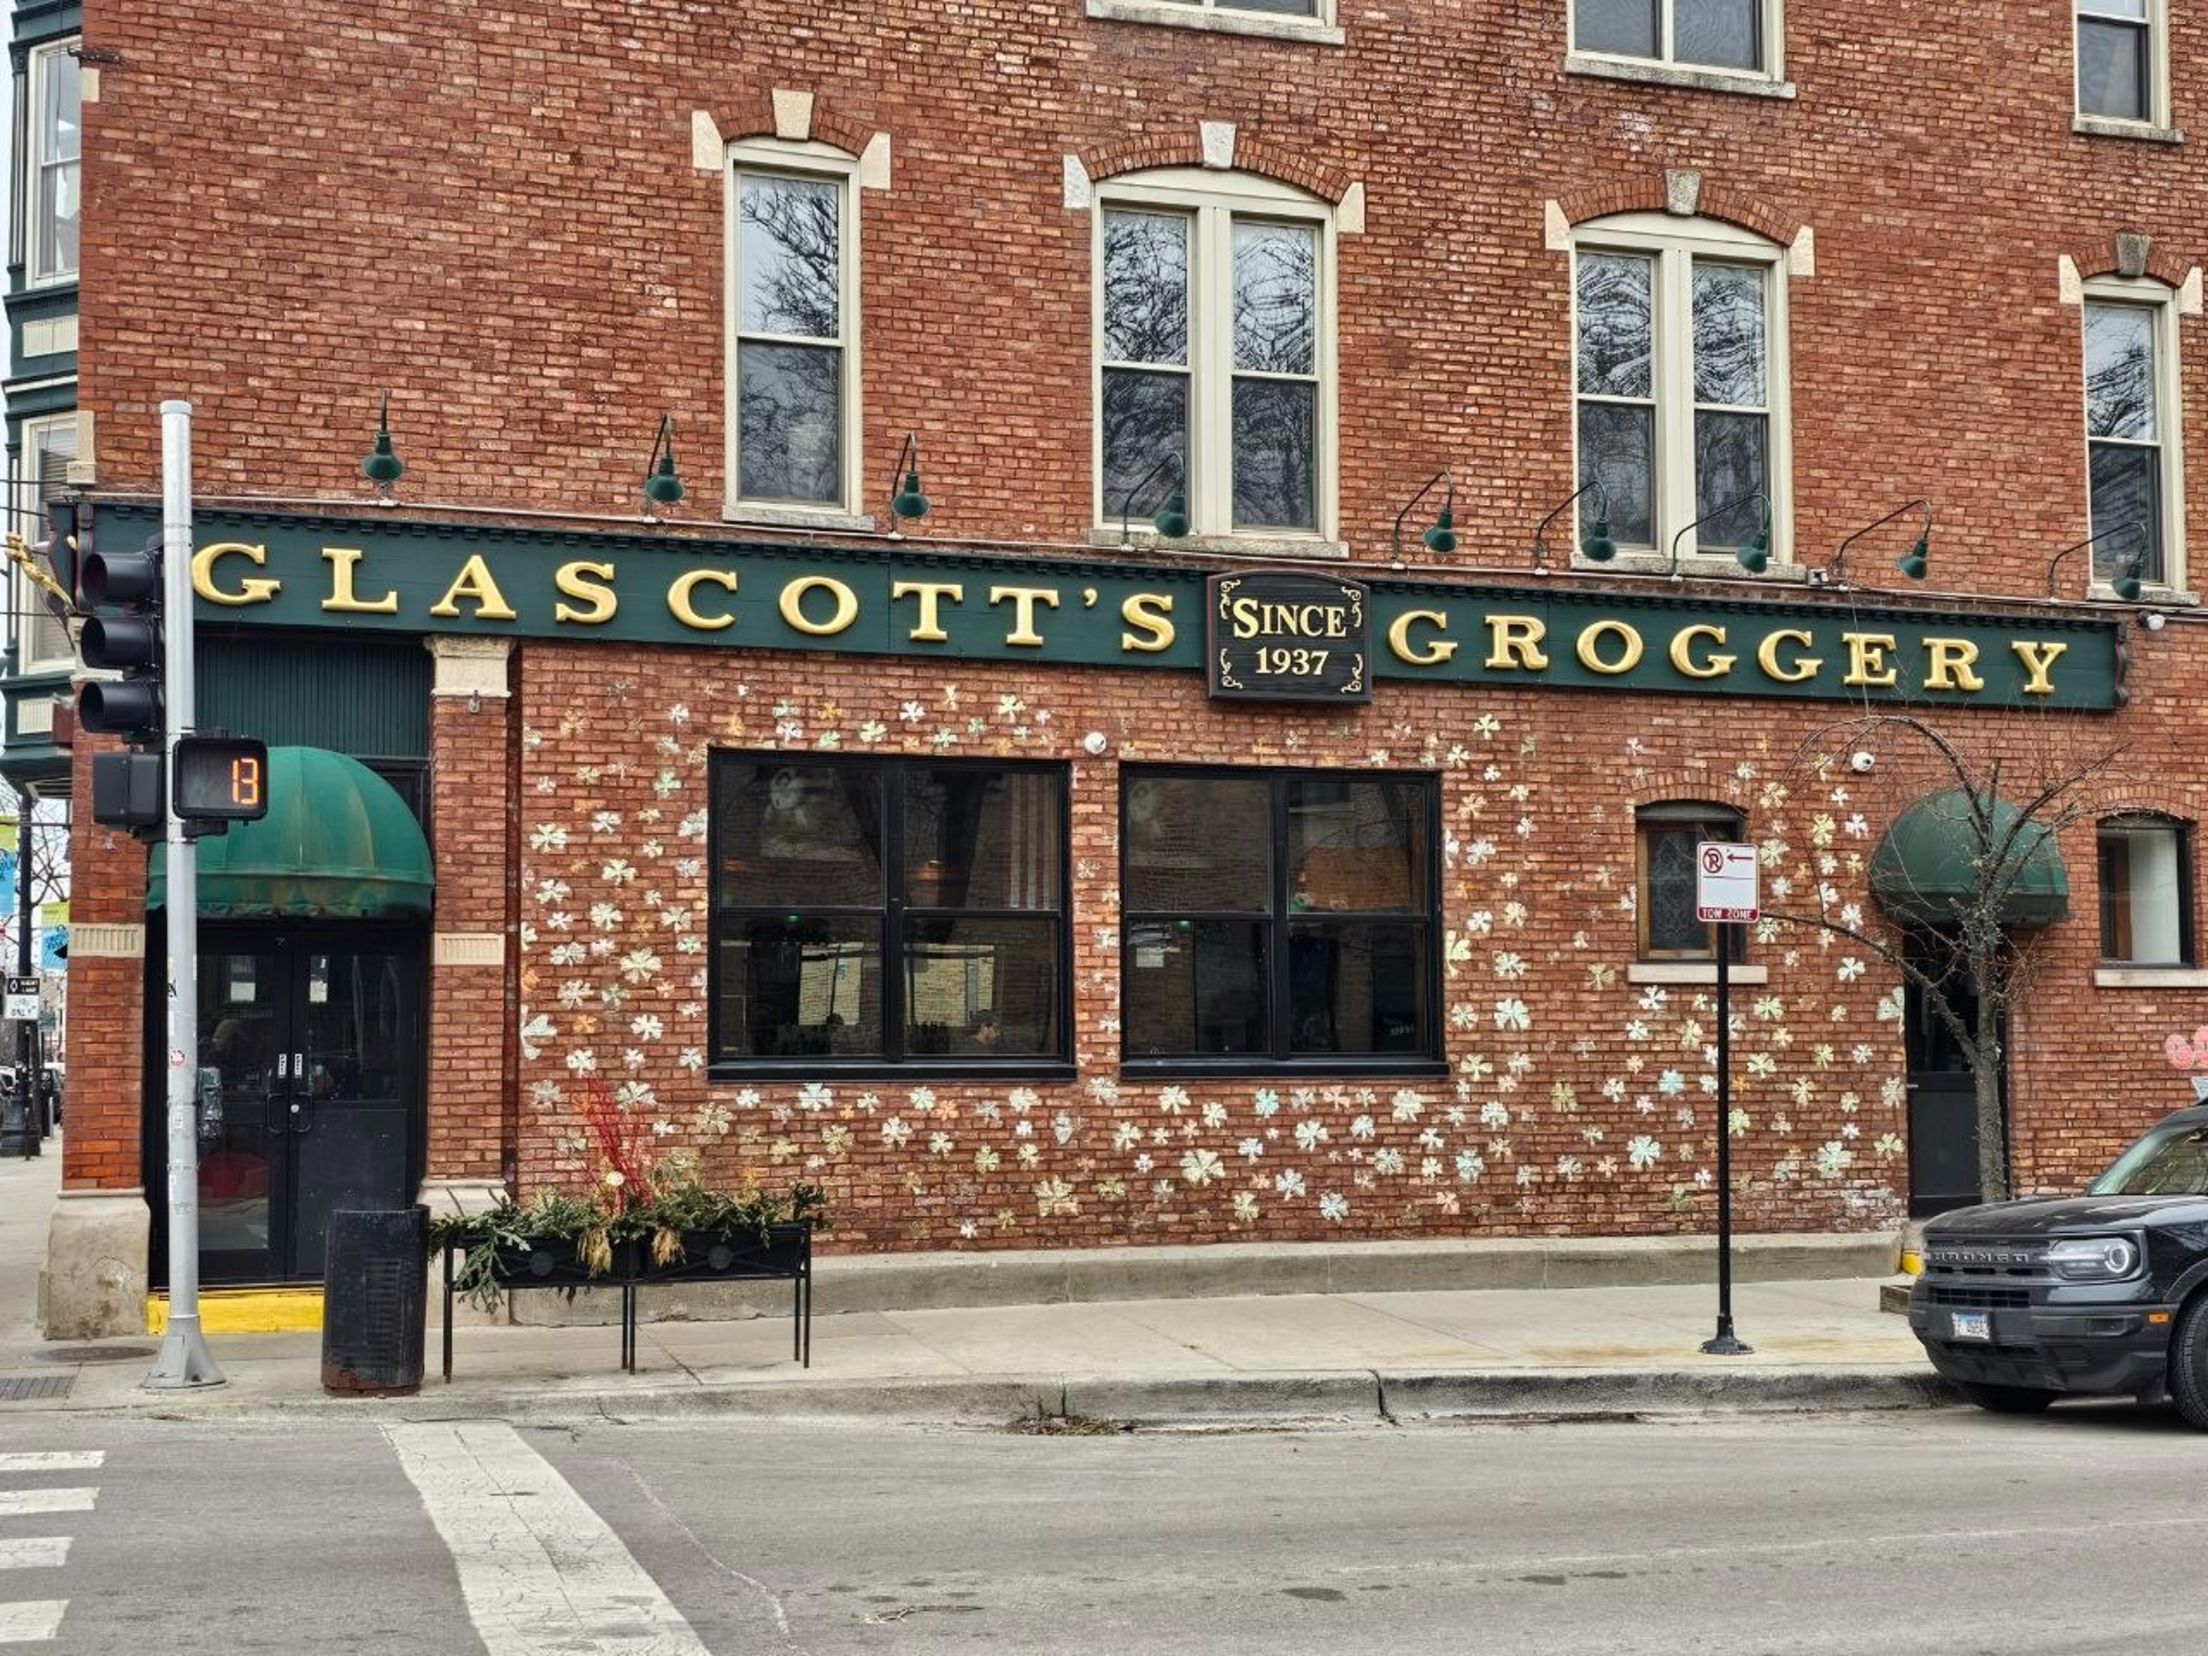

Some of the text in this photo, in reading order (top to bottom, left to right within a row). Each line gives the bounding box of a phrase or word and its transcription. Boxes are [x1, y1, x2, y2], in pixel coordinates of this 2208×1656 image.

[190, 541, 1177, 653] GLASCOTT'S
[1232, 597, 1347, 639] SINCE
[1255, 646, 1330, 676] 1937
[1386, 609, 2069, 695] GROGGERY
[231, 757, 260, 806] 13
[1726, 908, 1753, 920] ZONE
